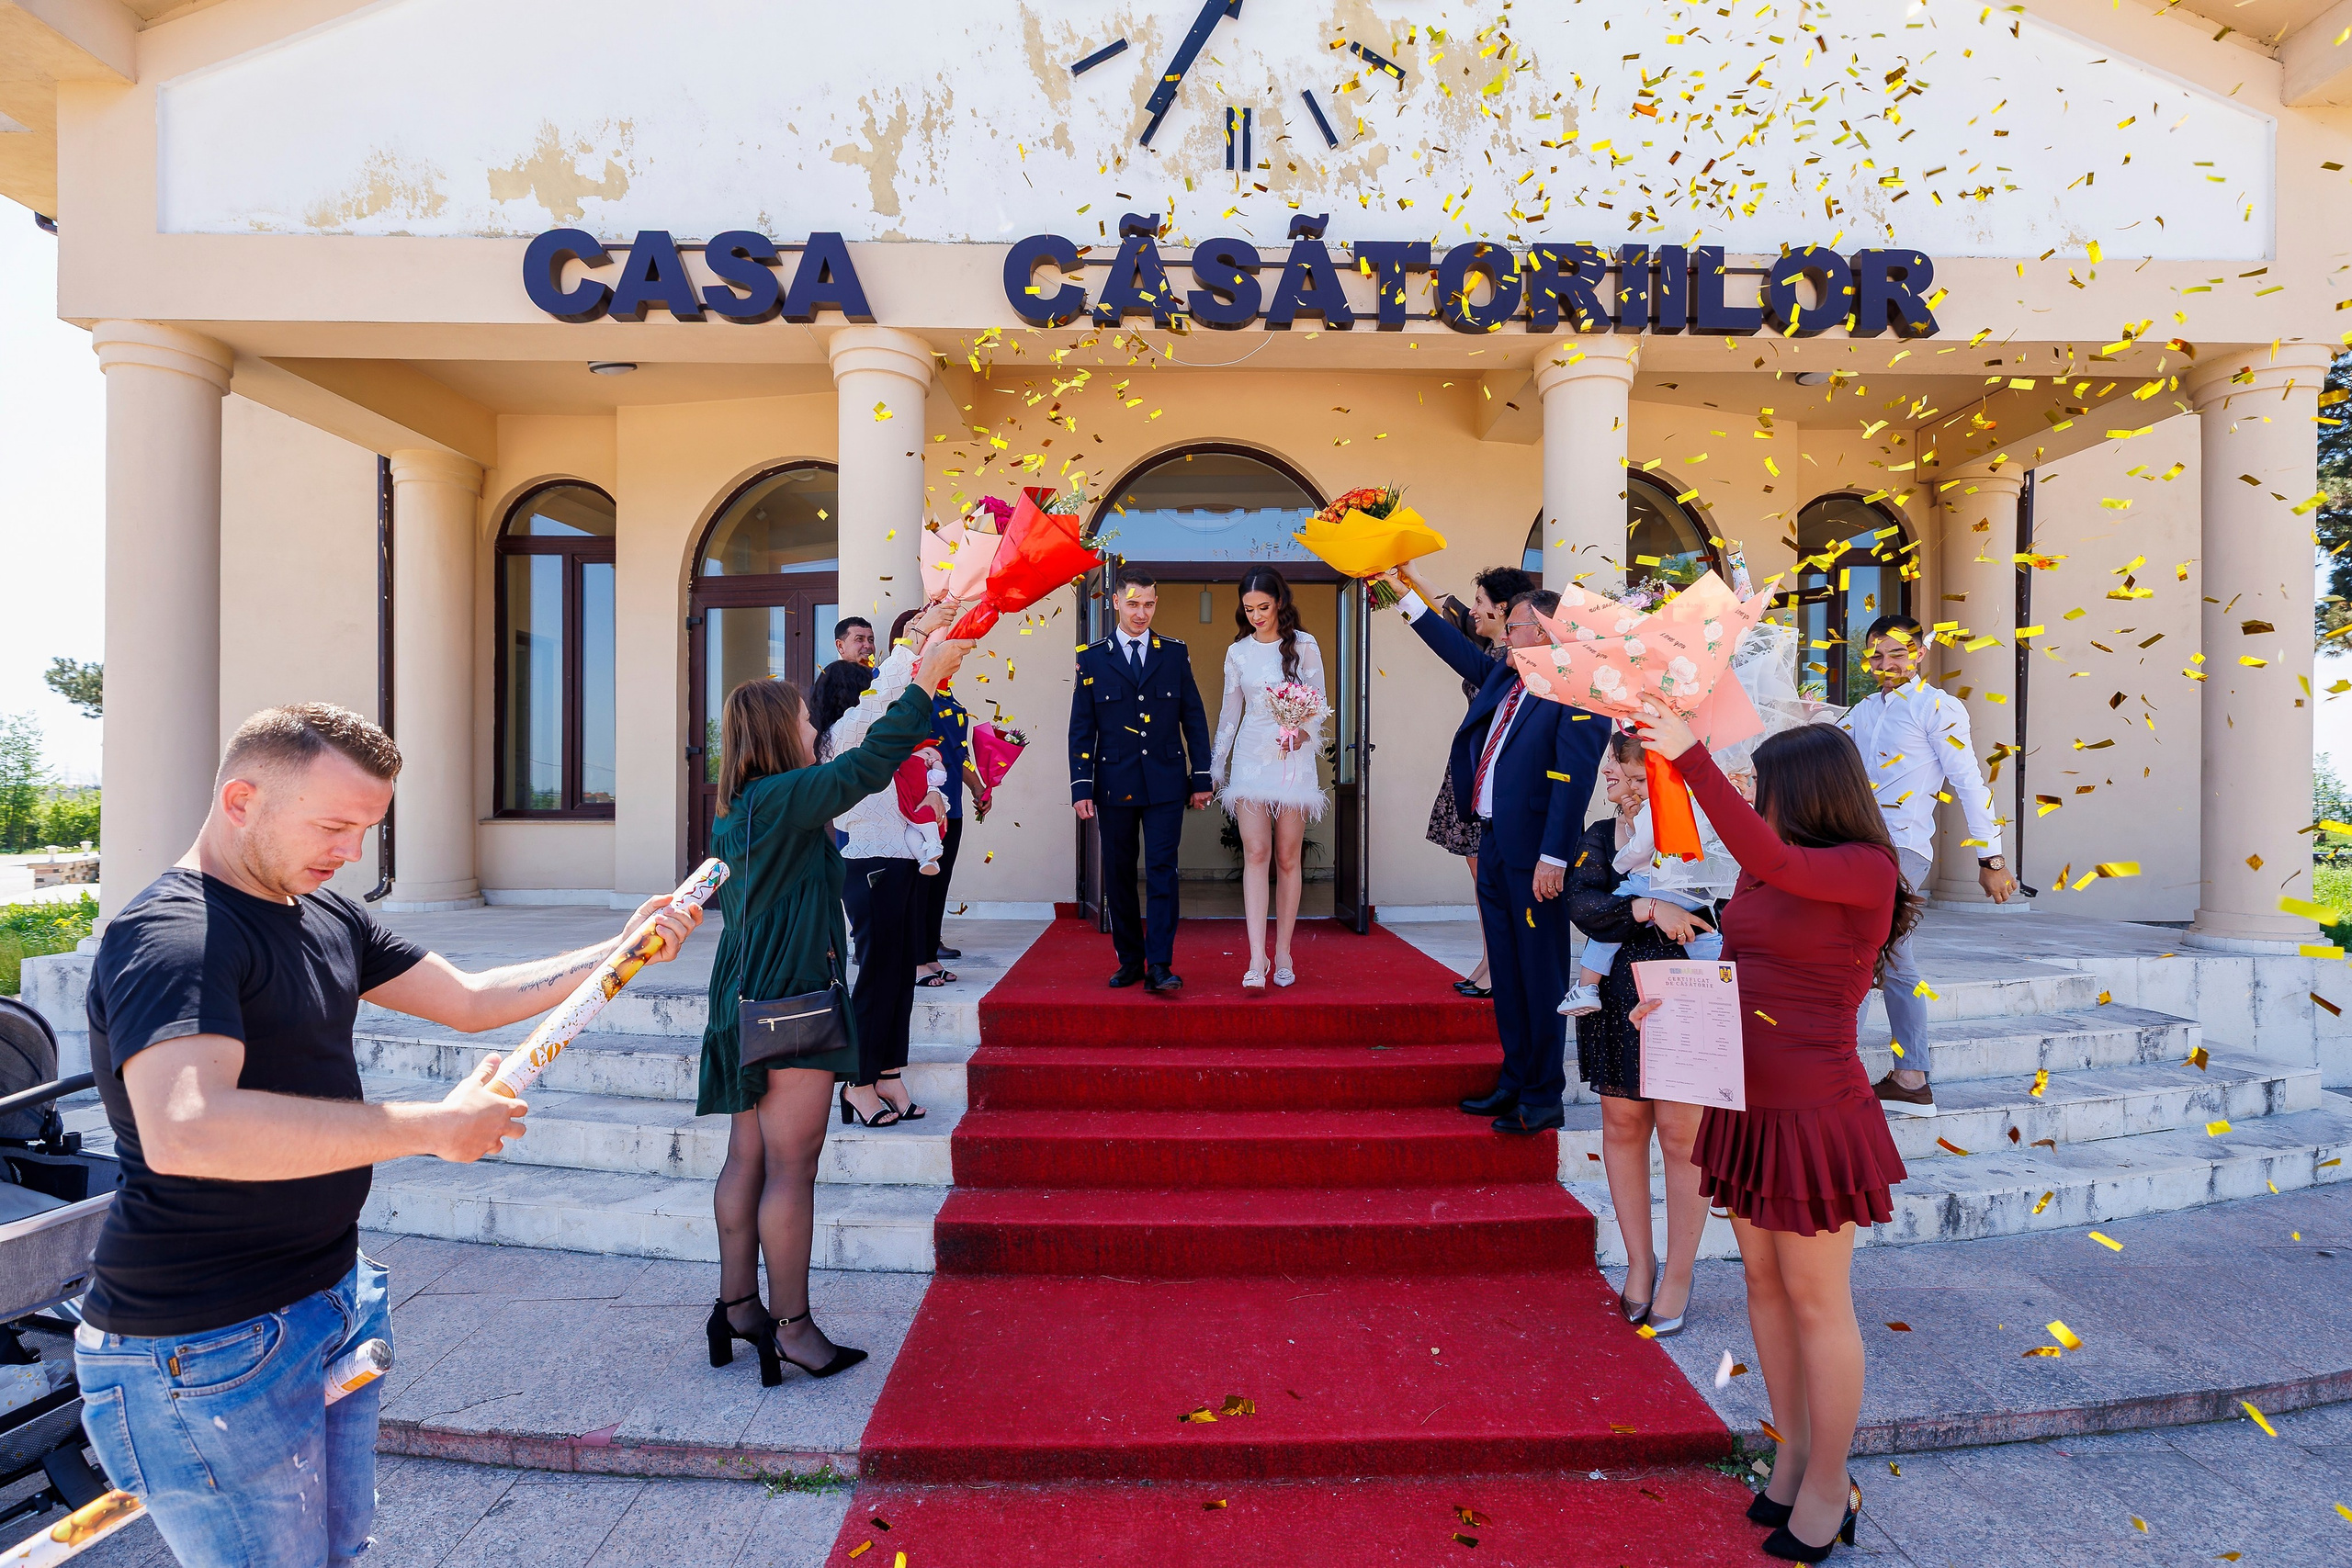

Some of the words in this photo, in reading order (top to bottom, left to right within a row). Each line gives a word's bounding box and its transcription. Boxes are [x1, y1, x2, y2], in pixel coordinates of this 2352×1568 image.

[522, 228, 877, 324] CASA
[1582, 644, 1597, 654] Love
[1659, 632, 1675, 642] Love
[1673, 640, 1687, 650] you
